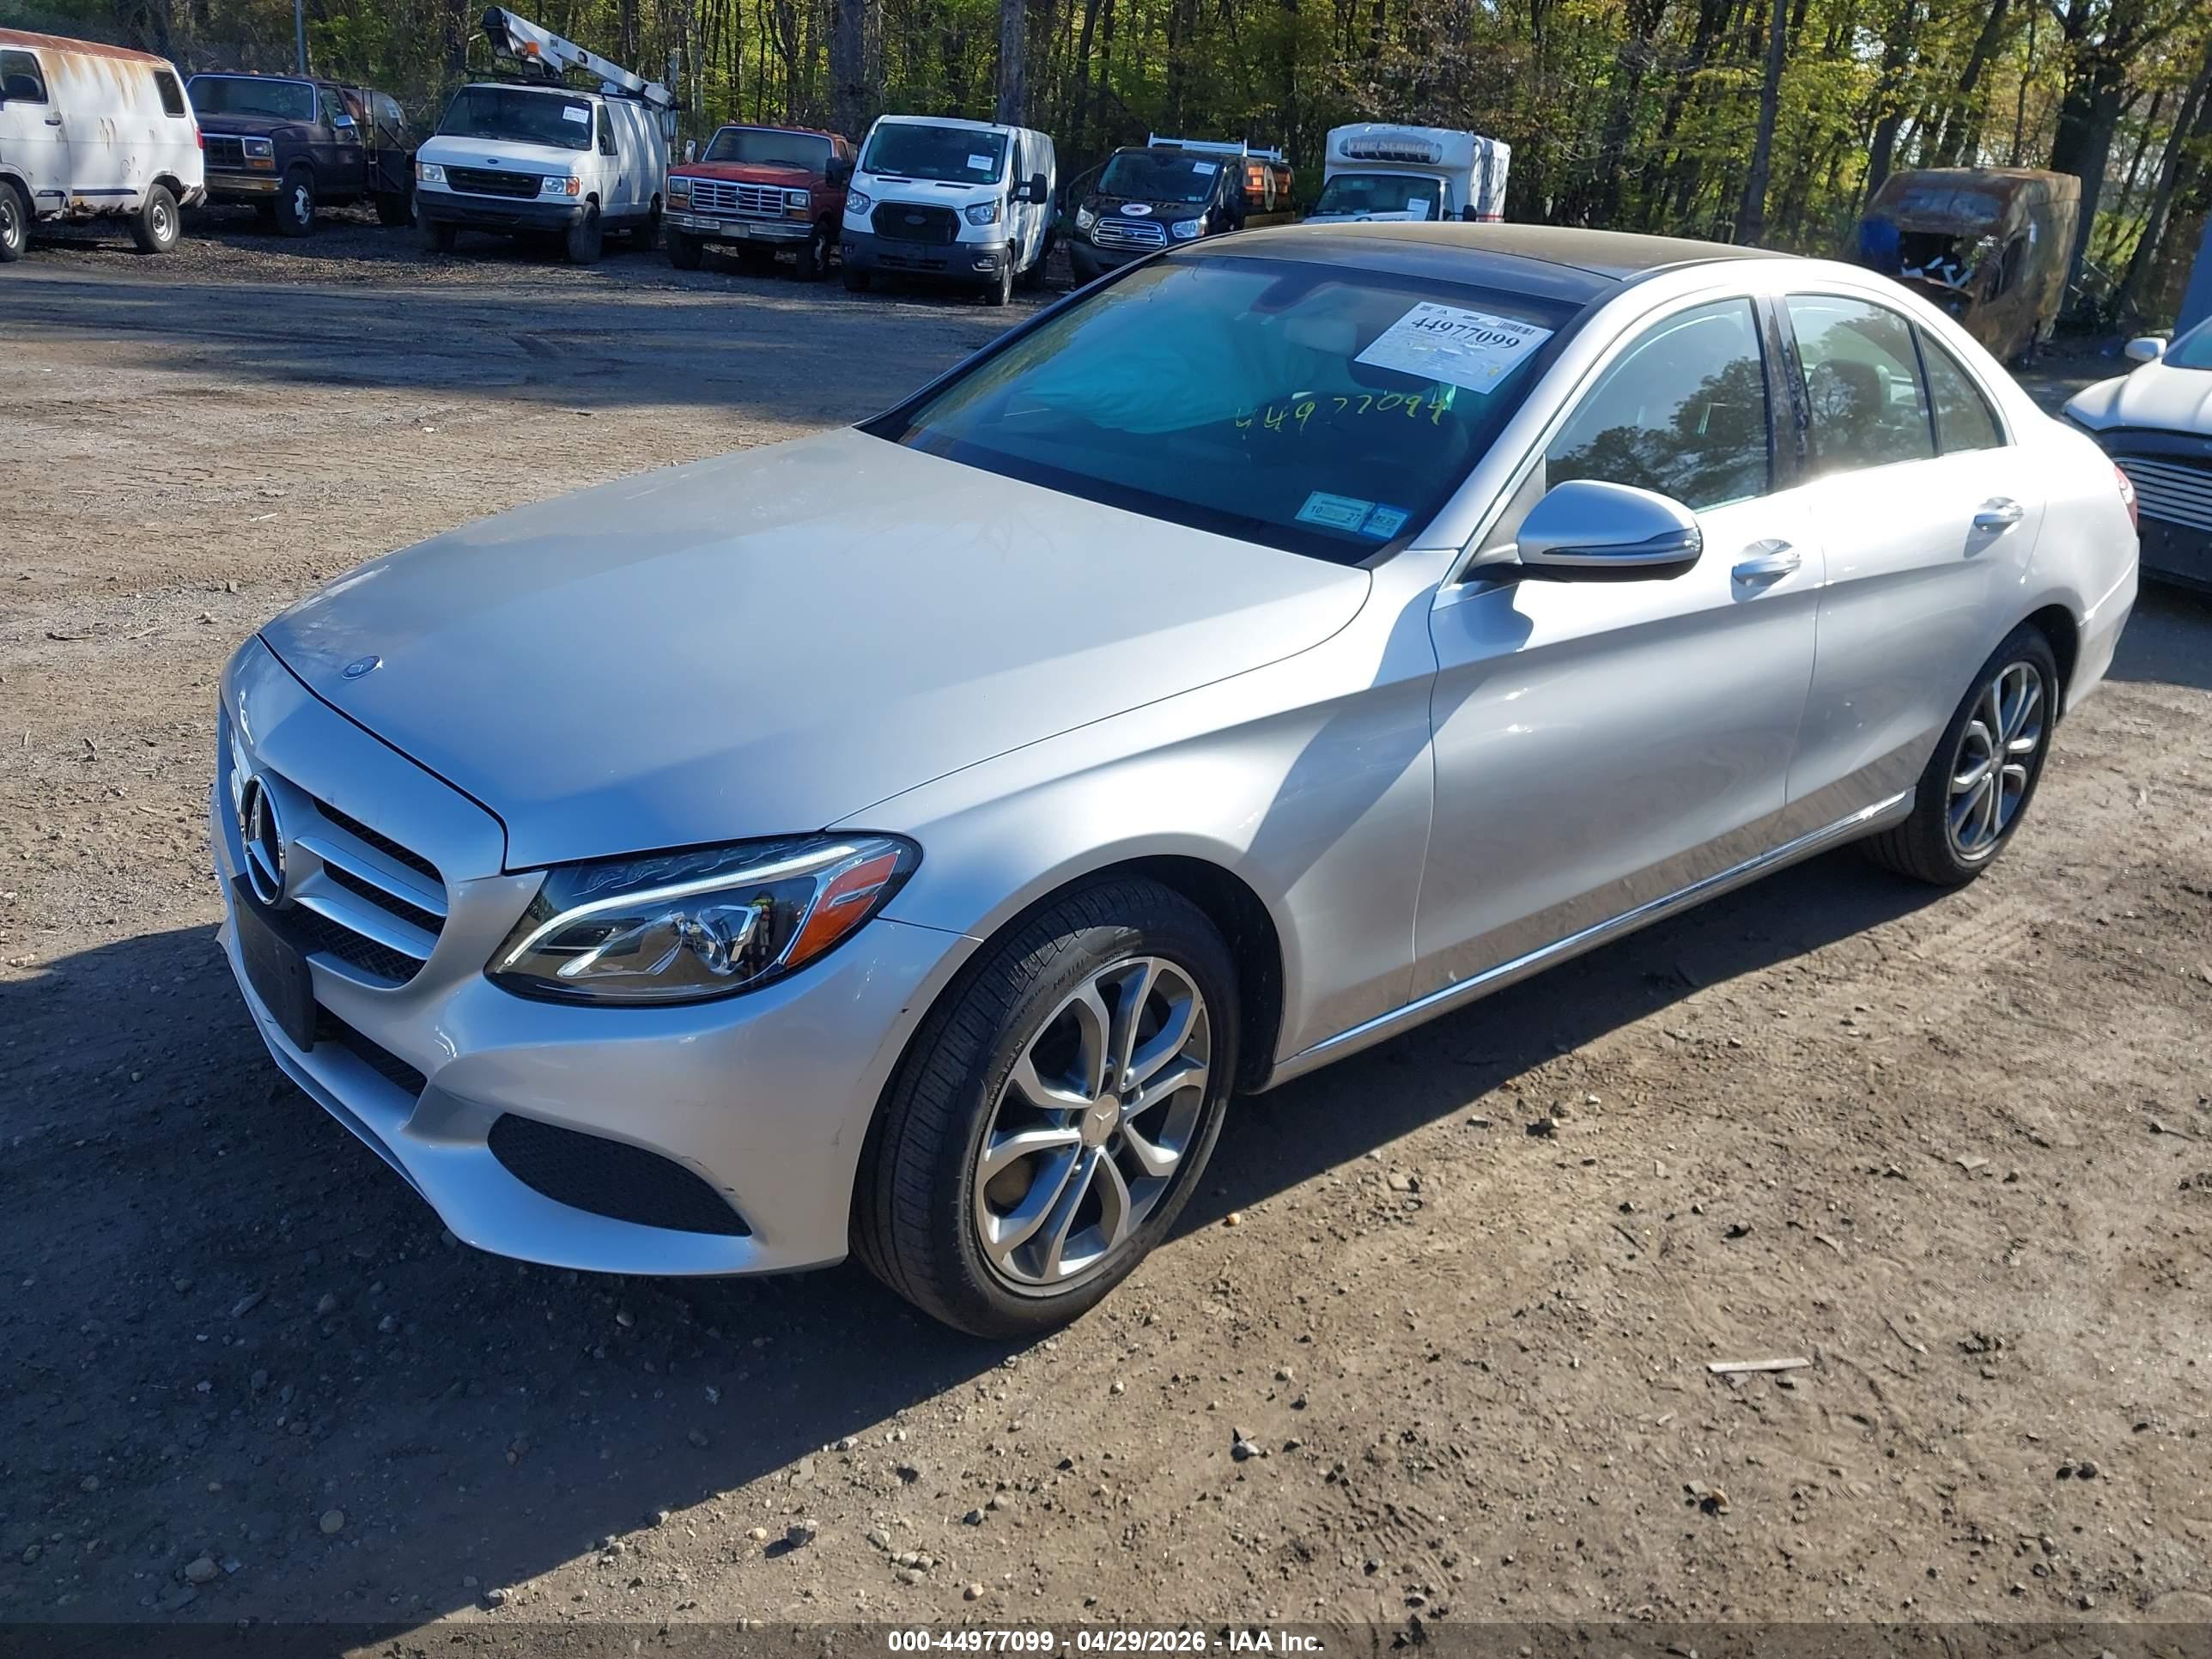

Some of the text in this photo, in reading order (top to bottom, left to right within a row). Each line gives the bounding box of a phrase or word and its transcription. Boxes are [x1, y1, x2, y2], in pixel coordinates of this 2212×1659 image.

[1411, 317, 1520, 349] 44977099
[1310, 505, 1323, 514] 10
[1346, 513, 1361, 522] 27
